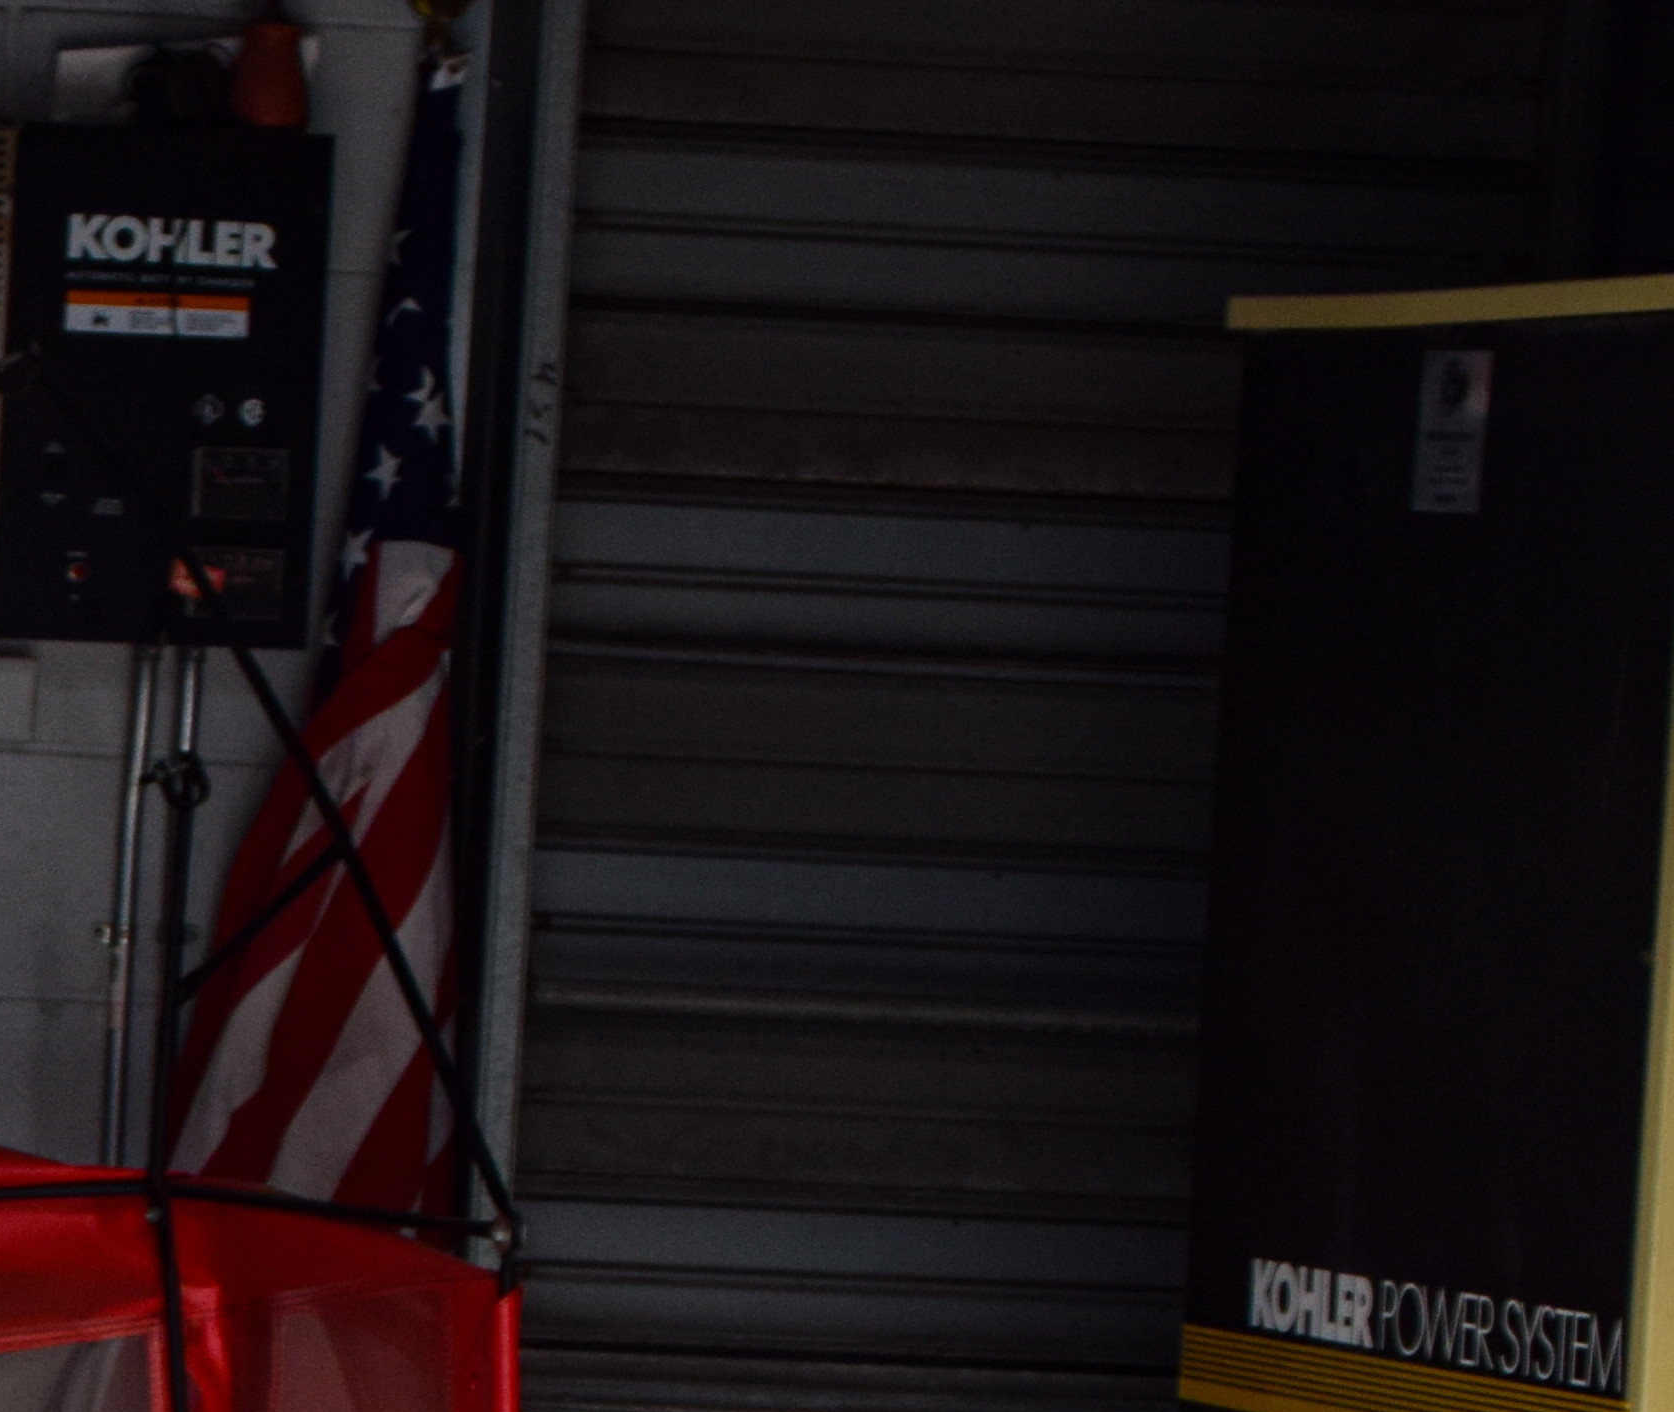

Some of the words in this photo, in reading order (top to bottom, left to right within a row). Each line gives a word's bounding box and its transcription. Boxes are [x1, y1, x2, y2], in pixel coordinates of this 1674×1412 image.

[67, 213, 278, 270] KOHLER
[1251, 1257, 1373, 1349] KOHLER
[1379, 1278, 1496, 1370] POWER
[1499, 1299, 1624, 1393] SYSTEM
